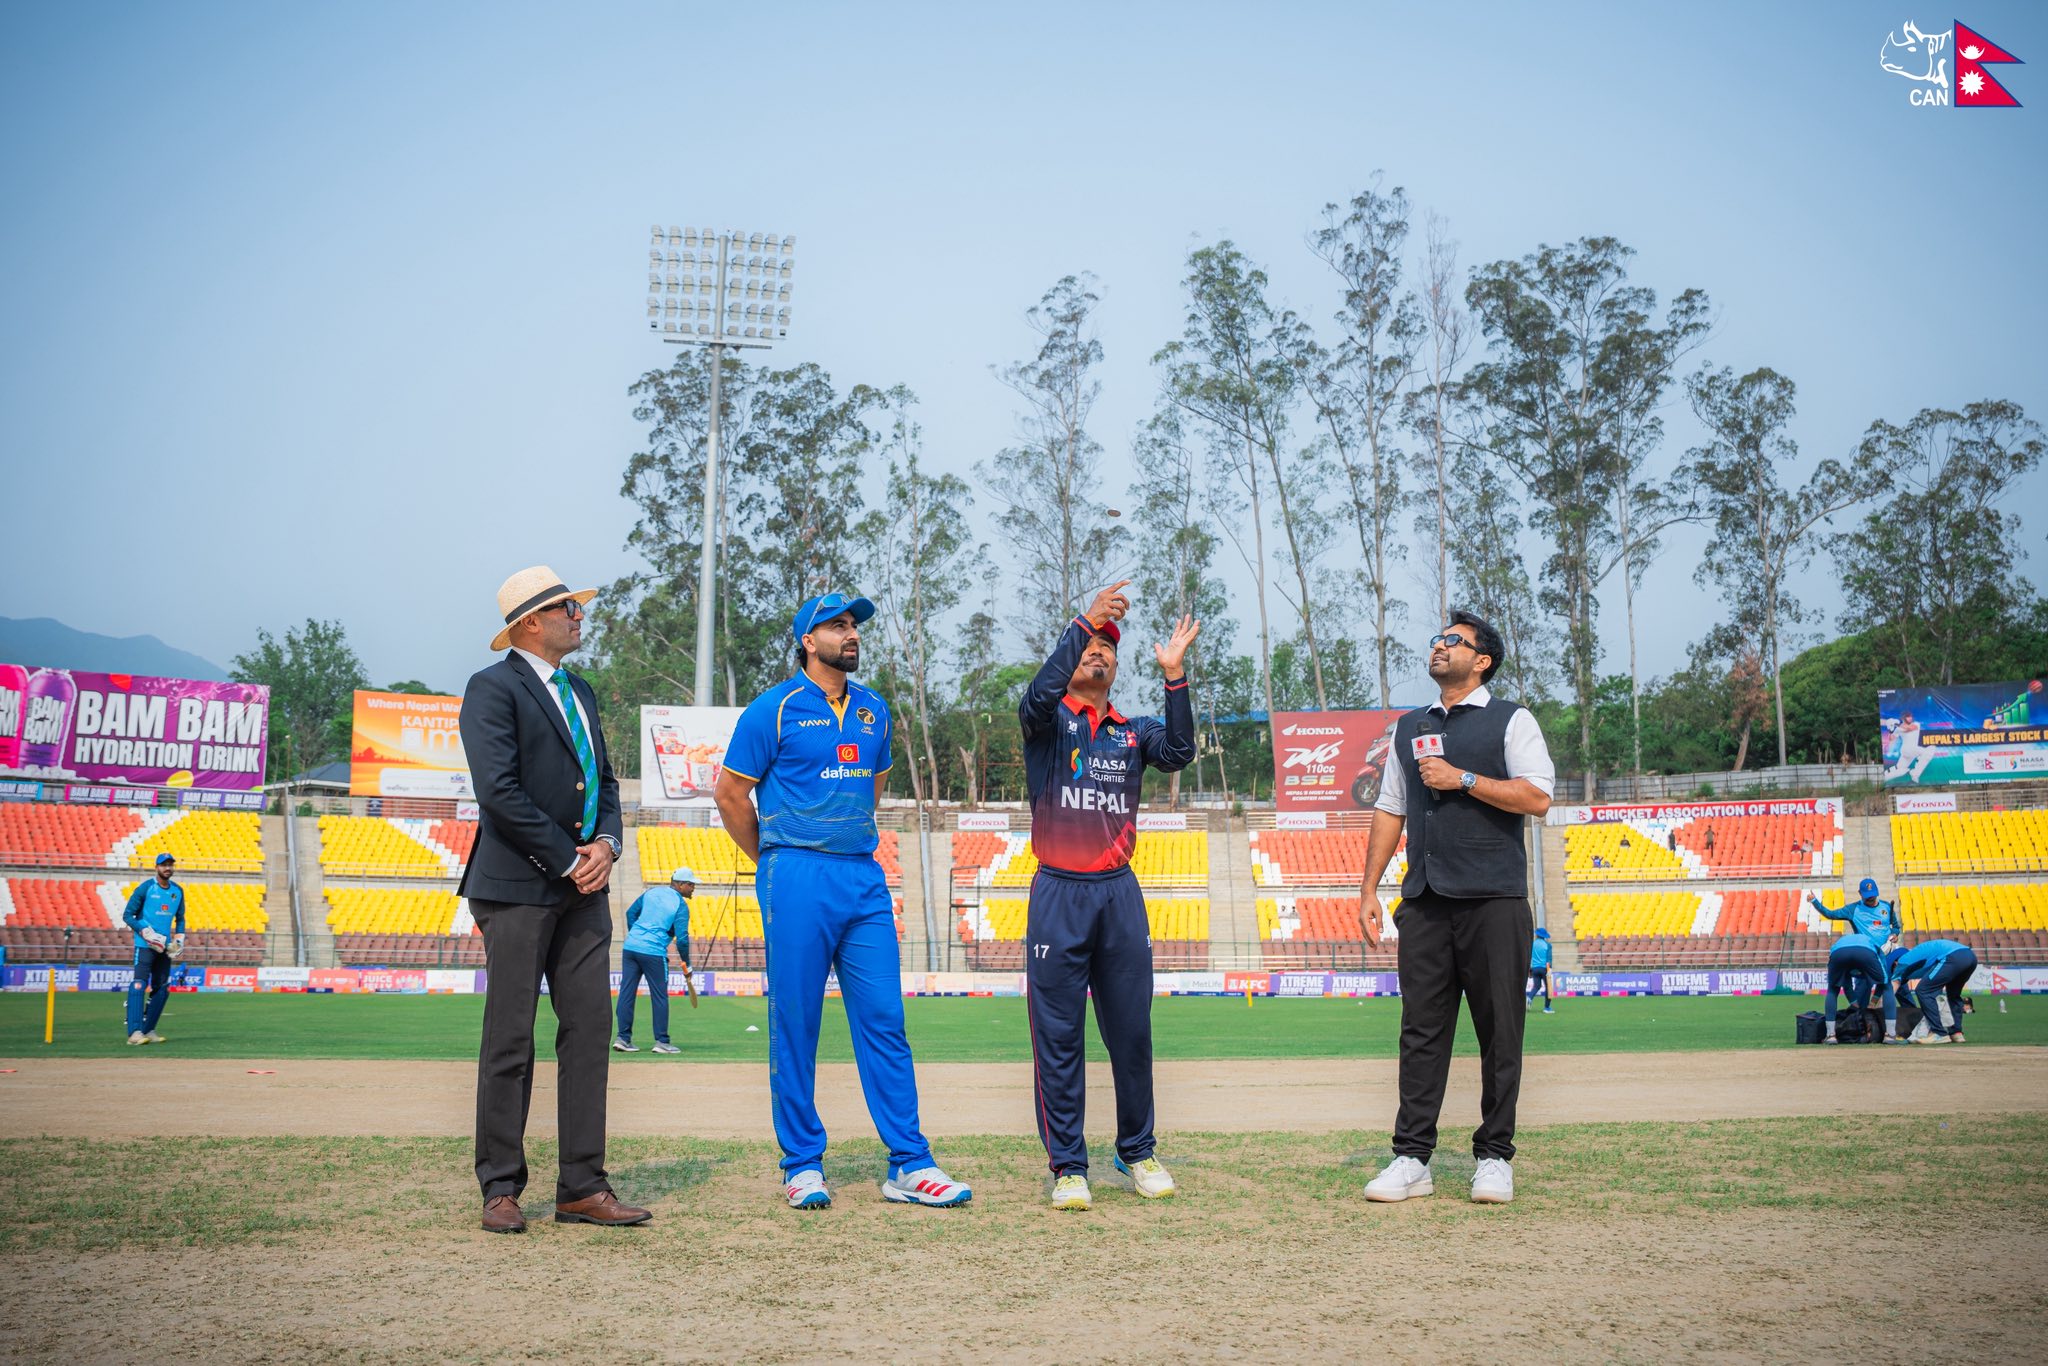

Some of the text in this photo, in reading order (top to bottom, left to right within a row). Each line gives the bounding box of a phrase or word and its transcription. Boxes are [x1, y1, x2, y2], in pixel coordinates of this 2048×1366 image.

[32, 695, 66, 720] BAM
[367, 698, 463, 713] Where Nepal Wa
[76, 690, 264, 745] BAM BAM
[401, 715, 460, 729] KANTIP
[1296, 727, 1345, 736] HONDA
[1922, 733, 1961, 746] NEPAL'S
[1963, 731, 2006, 744] LARGEST
[2008, 730, 2041, 742] STOCK
[74, 737, 261, 773] HYDRATION DRINK
[820, 765, 872, 779] dafaNEWS
[1306, 764, 1336, 774] 110cc
[1061, 785, 1130, 815] NEPAL
[1596, 802, 1814, 820] CRICKET ASSOCIATION OF NEPAL
[1033, 944, 1050, 959] 17
[24, 969, 80, 982] XTREME
[89, 970, 135, 982] XTREM
[222, 975, 255, 986] KFC
[363, 975, 393, 983] JUICE
[1279, 975, 1324, 987] XTREME
[1566, 976, 1598, 985] NAASA
[1661, 973, 1710, 985] XTREME
[1718, 972, 1768, 984] XTREME
[1782, 971, 1828, 984] MAX TIGE
[1192, 979, 1223, 988] MetLife
[1238, 979, 1267, 989] KFC
[1332, 976, 1377, 988] XTREME
